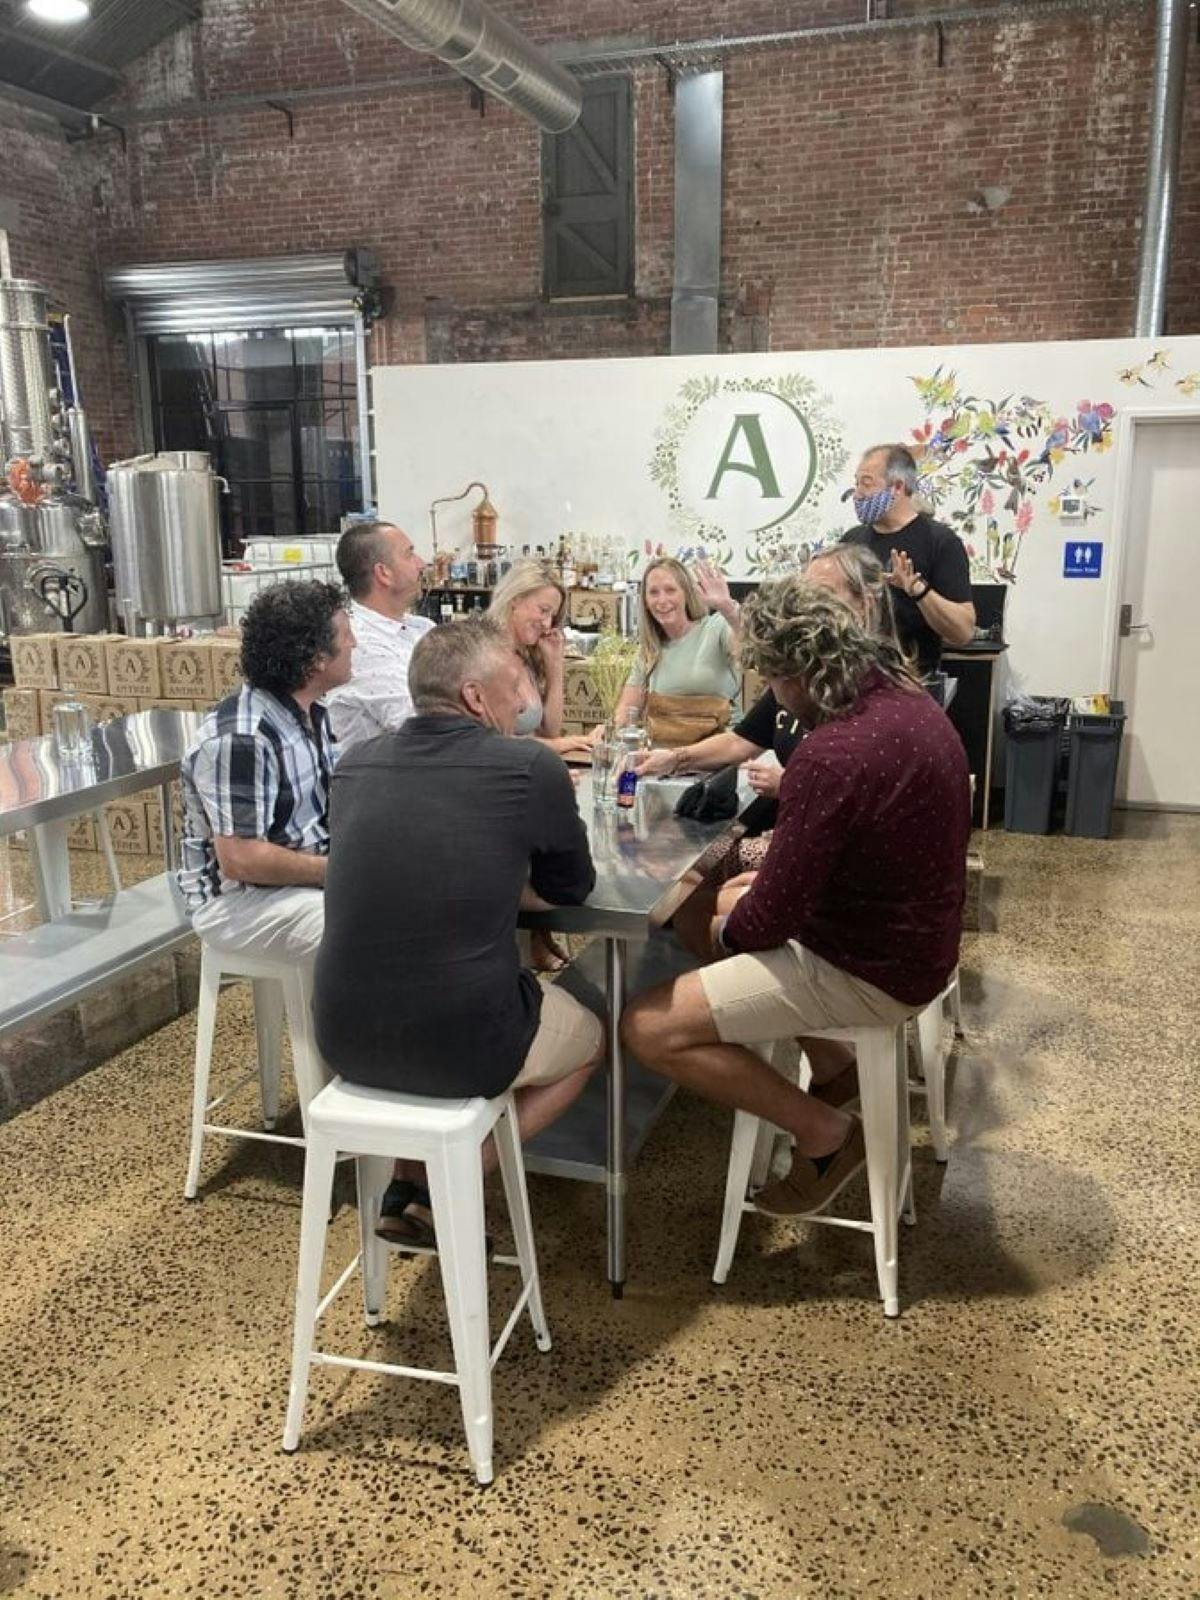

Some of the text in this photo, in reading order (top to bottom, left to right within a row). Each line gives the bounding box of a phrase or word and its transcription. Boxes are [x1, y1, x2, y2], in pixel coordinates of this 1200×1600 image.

[704, 413, 785, 500] A
[75, 654, 86, 670] A
[125, 658, 137, 674] A
[178, 660, 191, 675] A
[575, 680, 589, 696] A
[113, 815, 126, 831] A
